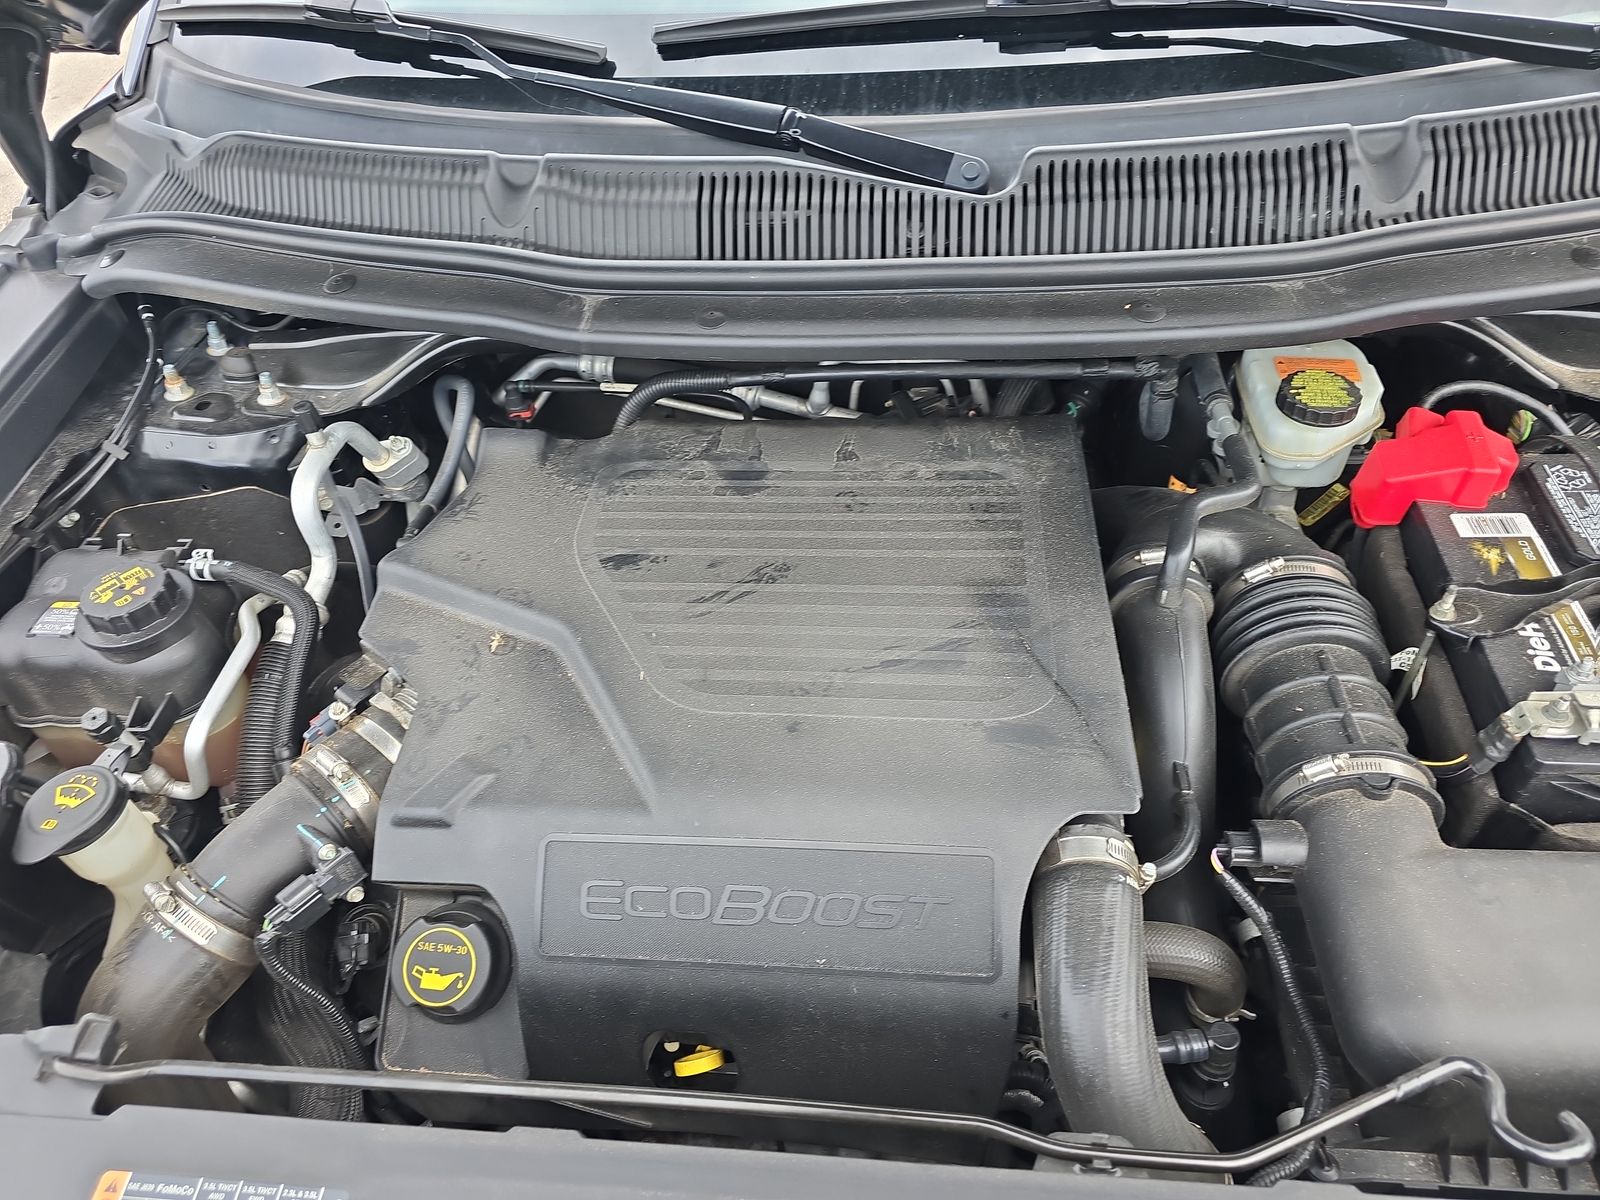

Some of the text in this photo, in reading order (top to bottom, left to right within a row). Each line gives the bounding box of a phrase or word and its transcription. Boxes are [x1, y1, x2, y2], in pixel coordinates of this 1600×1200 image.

[417, 941, 468, 955] SAE 5W-30
[156, 1183, 194, 1196] FoMoCo
